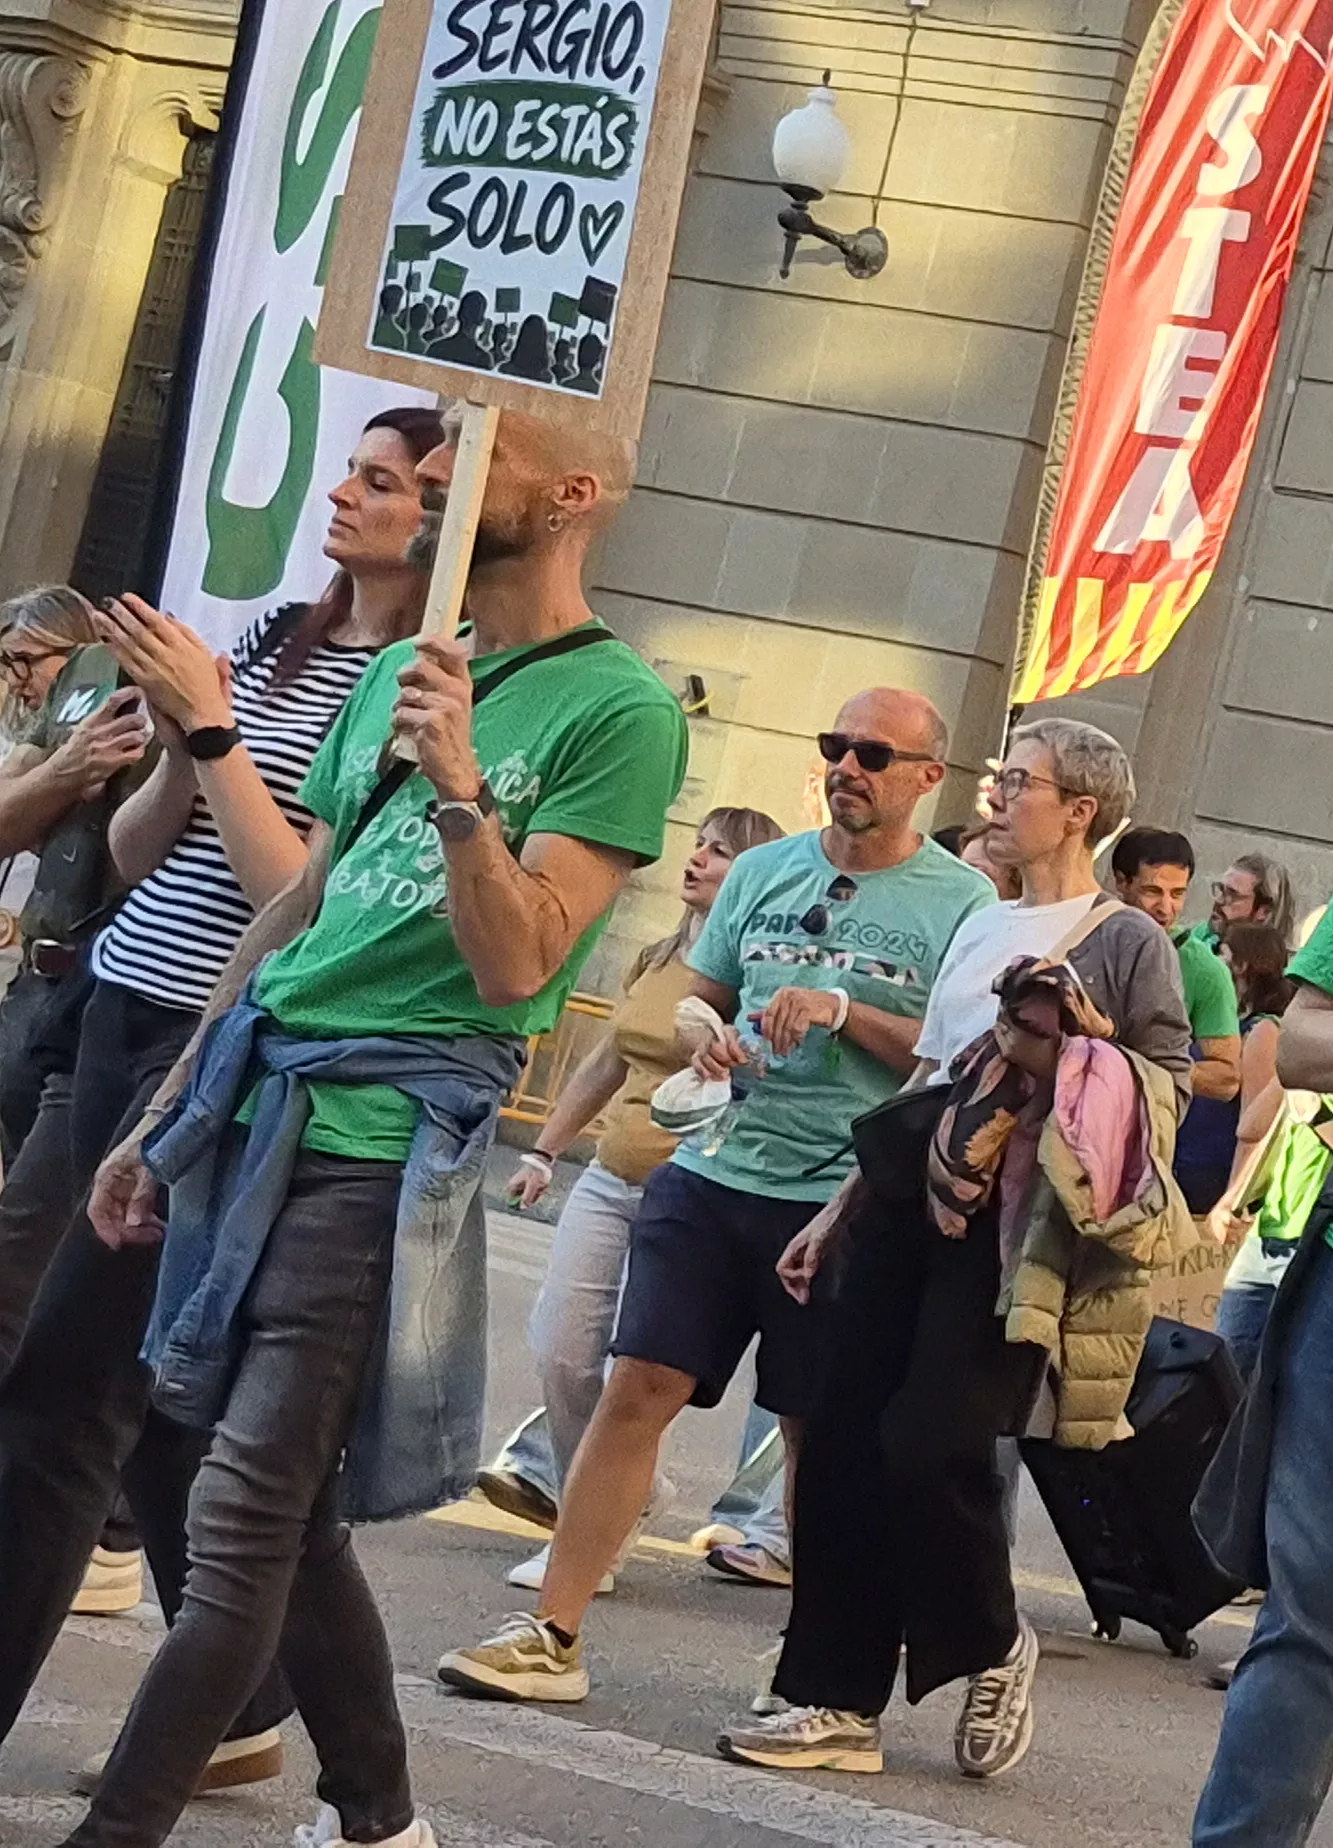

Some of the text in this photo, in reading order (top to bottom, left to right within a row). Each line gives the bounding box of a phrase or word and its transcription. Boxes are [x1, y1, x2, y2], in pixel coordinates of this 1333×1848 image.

[432, 0, 645, 94] SERGIO,
[433, 96, 629, 170] NO ESTÁS
[424, 171, 576, 255] SOLO
[838, 918, 929, 963] 2024
